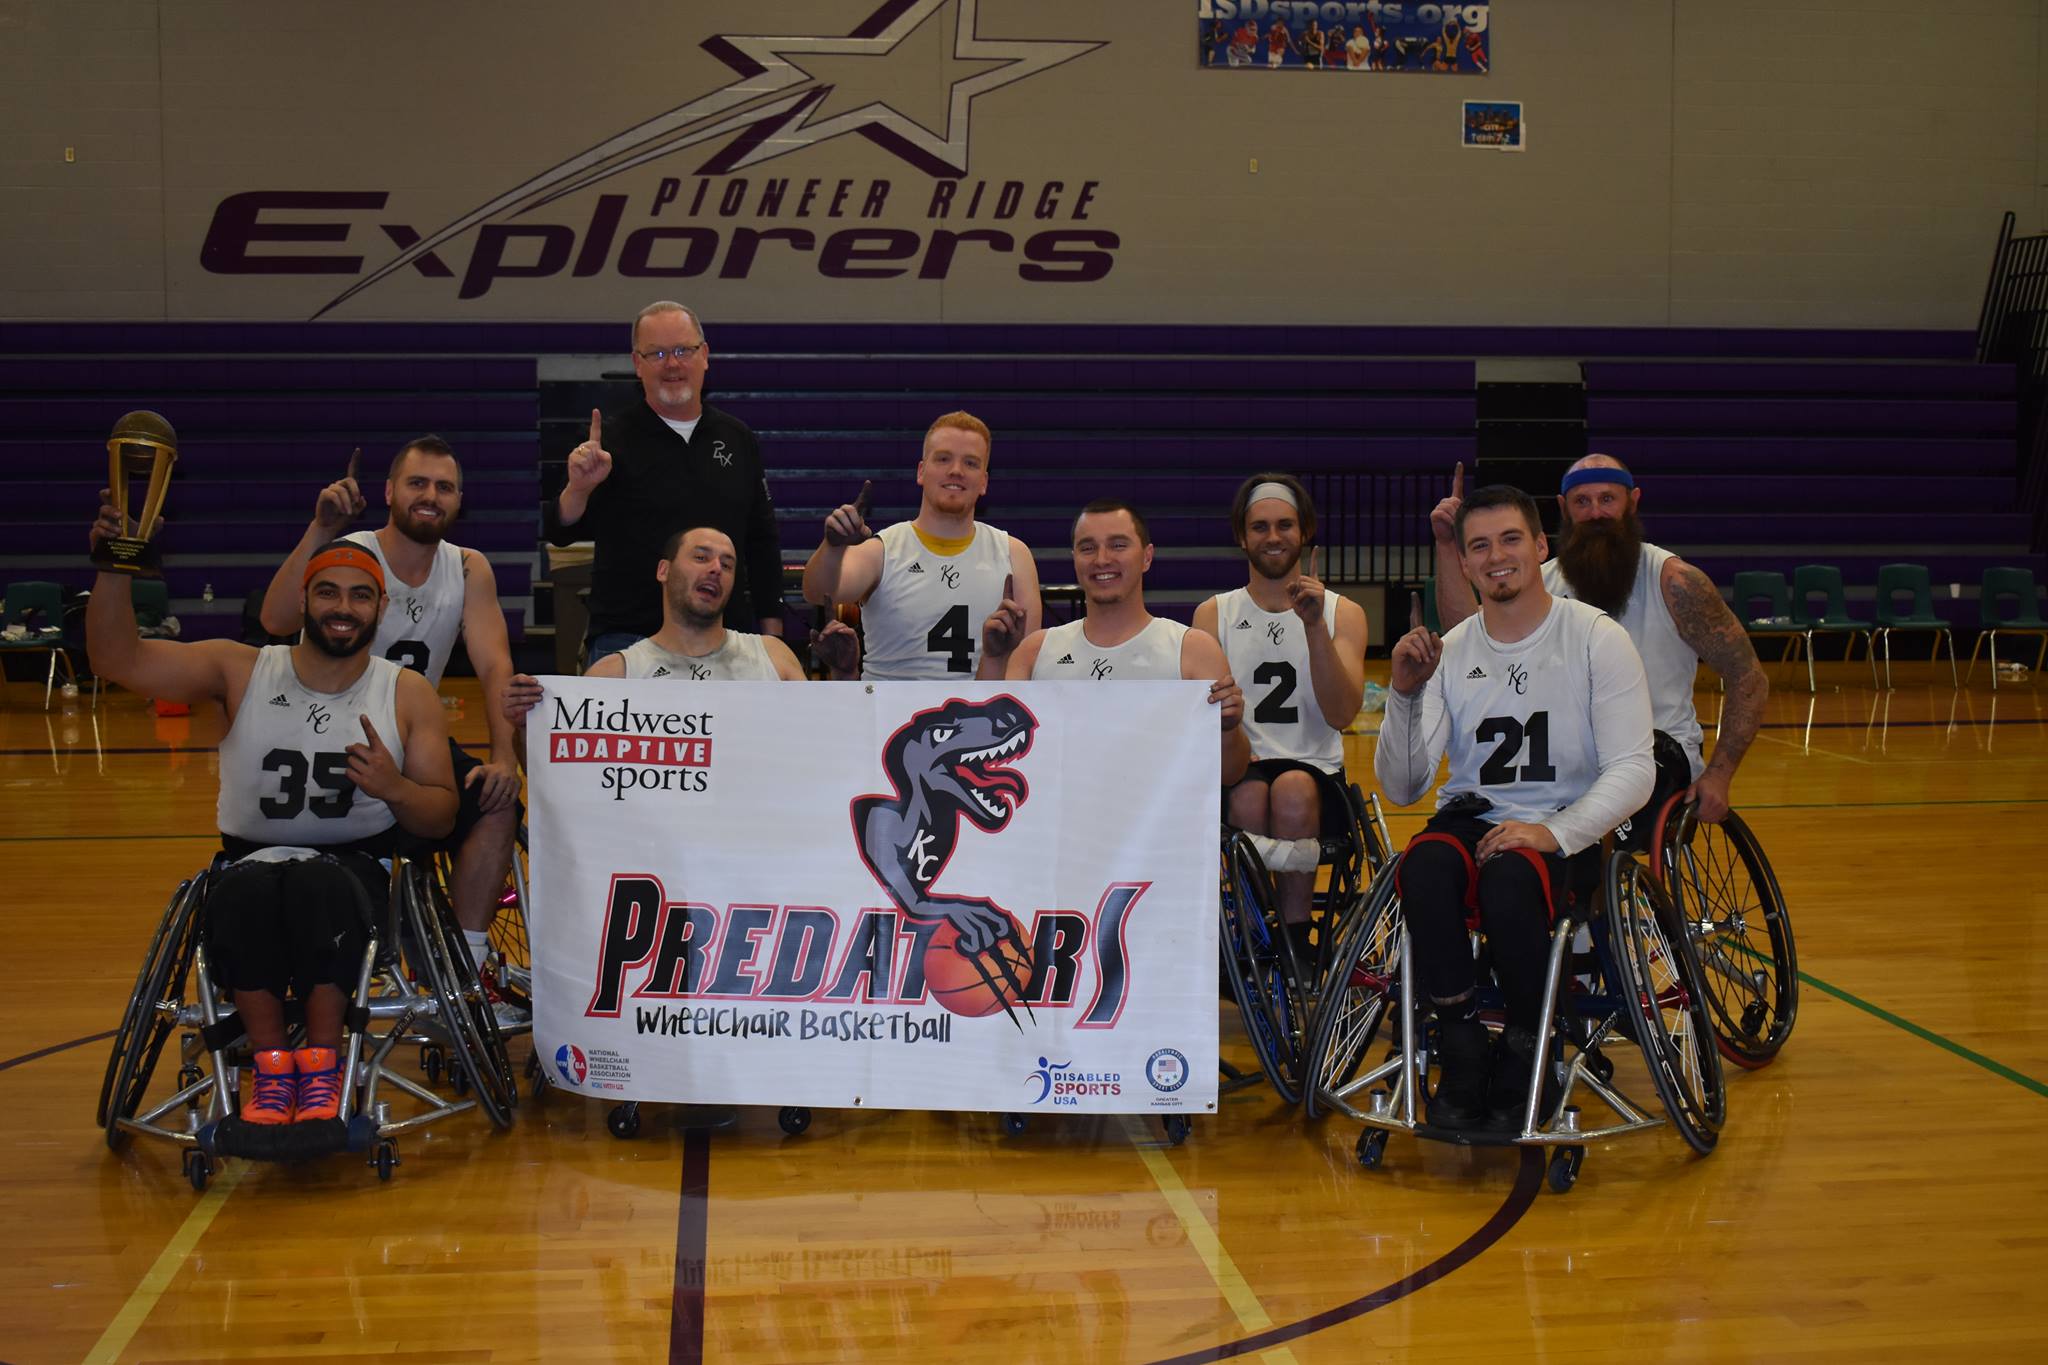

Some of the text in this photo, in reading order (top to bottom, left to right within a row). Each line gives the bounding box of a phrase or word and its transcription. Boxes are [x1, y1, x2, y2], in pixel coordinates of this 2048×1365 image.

[651, 178, 1099, 220] PIONEER RIDGE
[200, 190, 1121, 299] Explorers
[926, 604, 976, 673] 4
[1252, 660, 1299, 724] 2
[1507, 663, 1528, 695] KC
[306, 703, 330, 735] KC
[552, 696, 714, 735] Midwest
[555, 738, 707, 764] ADAPTIVE
[1475, 711, 1556, 786] 21
[259, 748, 357, 820] 35
[601, 766, 708, 801] sports
[907, 829, 939, 882] KC
[588, 1049, 620, 1057] NATIONAL
[589, 1056, 630, 1064] WHEELCHAIR
[589, 1063, 629, 1071] BASKETBALL
[589, 1070, 631, 1078] ASSOCIATION
[1054, 1073, 1121, 1082] DISABLED
[1054, 1083, 1121, 1096] SPORTS
[1054, 1096, 1078, 1105] USA
